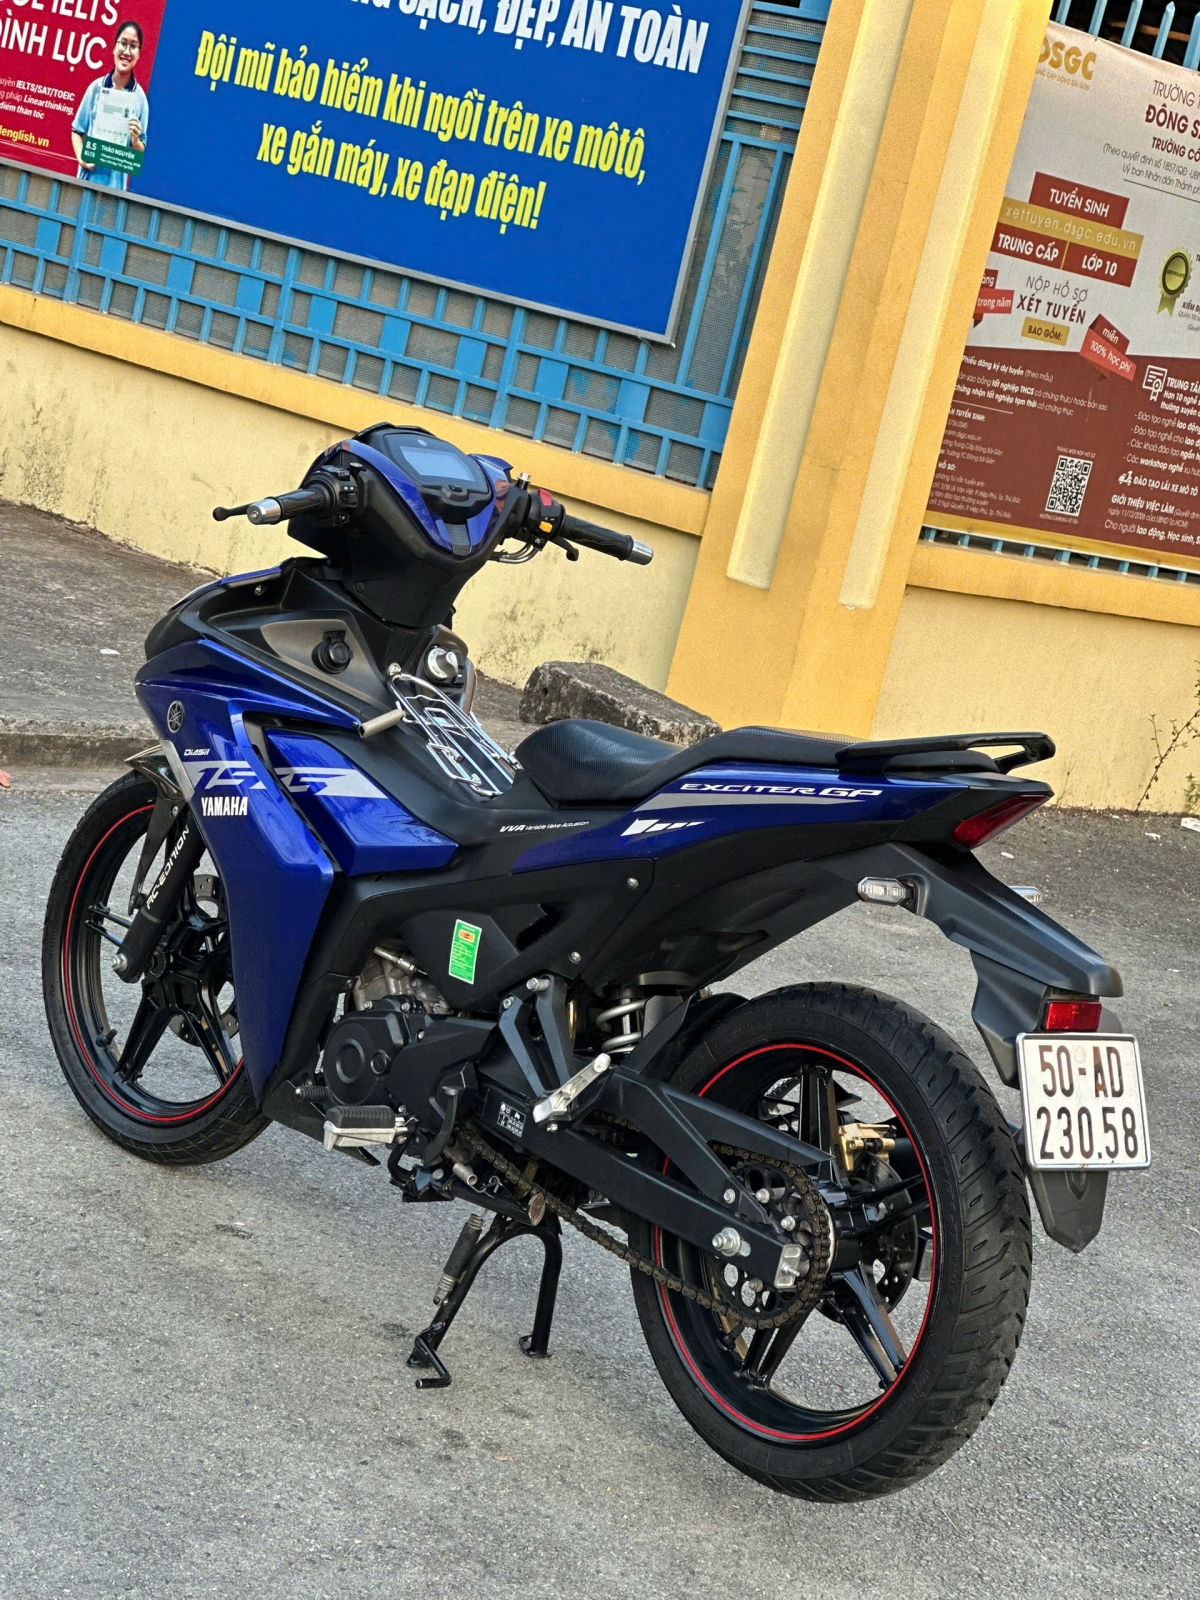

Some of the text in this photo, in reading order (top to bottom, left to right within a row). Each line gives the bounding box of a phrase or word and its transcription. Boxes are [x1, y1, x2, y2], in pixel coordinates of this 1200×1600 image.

[0, 9, 107, 71] ÌNH LỰC
[494, 0, 559, 50] ĐẸP,
[561, 0, 612, 53] AN
[616, 4, 709, 74] TOÀN
[16, 79, 75, 101] IELTS/SAT/TOEIC
[1153, 79, 1195, 107] TRƯỜNG
[195, 30, 646, 186] Đội mũ bảo hiểm khi ngồi trên xe môtô,
[1145, 103, 1189, 133] ĐÔNG
[86, 141, 97, 151] 8.5
[1151, 136, 1186, 157] TRƯỜNG
[256, 120, 547, 235] xe gắn máy, xe đạp điện!
[1050, 187, 1110, 218] TUYỂN SINH
[1005, 206, 1136, 251] xettuyen.dsgc.edu.vn
[997, 233, 1118, 276] TRUNG CẤP LỚP 10
[1026, 275, 1051, 294] NỘP
[996, 297, 1012, 308] năm
[1016, 293, 1087, 324] XÉT TUYỂN
[1027, 325, 1042, 336] BAO
[1090, 341, 1132, 373] 100% học phí
[1020, 385, 1034, 396] THCS
[1166, 377, 1200, 393] TRUNG TÂ
[1176, 393, 1183, 402] 10
[1176, 420, 1187, 429] lao
[1173, 435, 1184, 444] cho
[1184, 436, 1195, 446] lao
[1140, 458, 1168, 470] workshop
[1133, 475, 1147, 486] ĐÀO
[1148, 479, 1160, 490] TẠO
[1160, 480, 1171, 491] LÁI
[1170, 484, 1179, 493] XE
[1127, 497, 1145, 510] THIỆU
[1146, 500, 1160, 513] VIỆC
[1160, 502, 1175, 514] LÀM
[1104, 519, 1118, 530] Cho
[1136, 525, 1147, 535] lao
[1167, 531, 1180, 542] Học
[1181, 534, 1195, 545] sinh,
[680, 783, 883, 798] EXCITER GP
[201, 796, 248, 816] YAMAHA
[500, 824, 526, 832] VVA
[1038, 1044, 1124, 1098] 50-AD
[1036, 1106, 1139, 1159] 230.58
